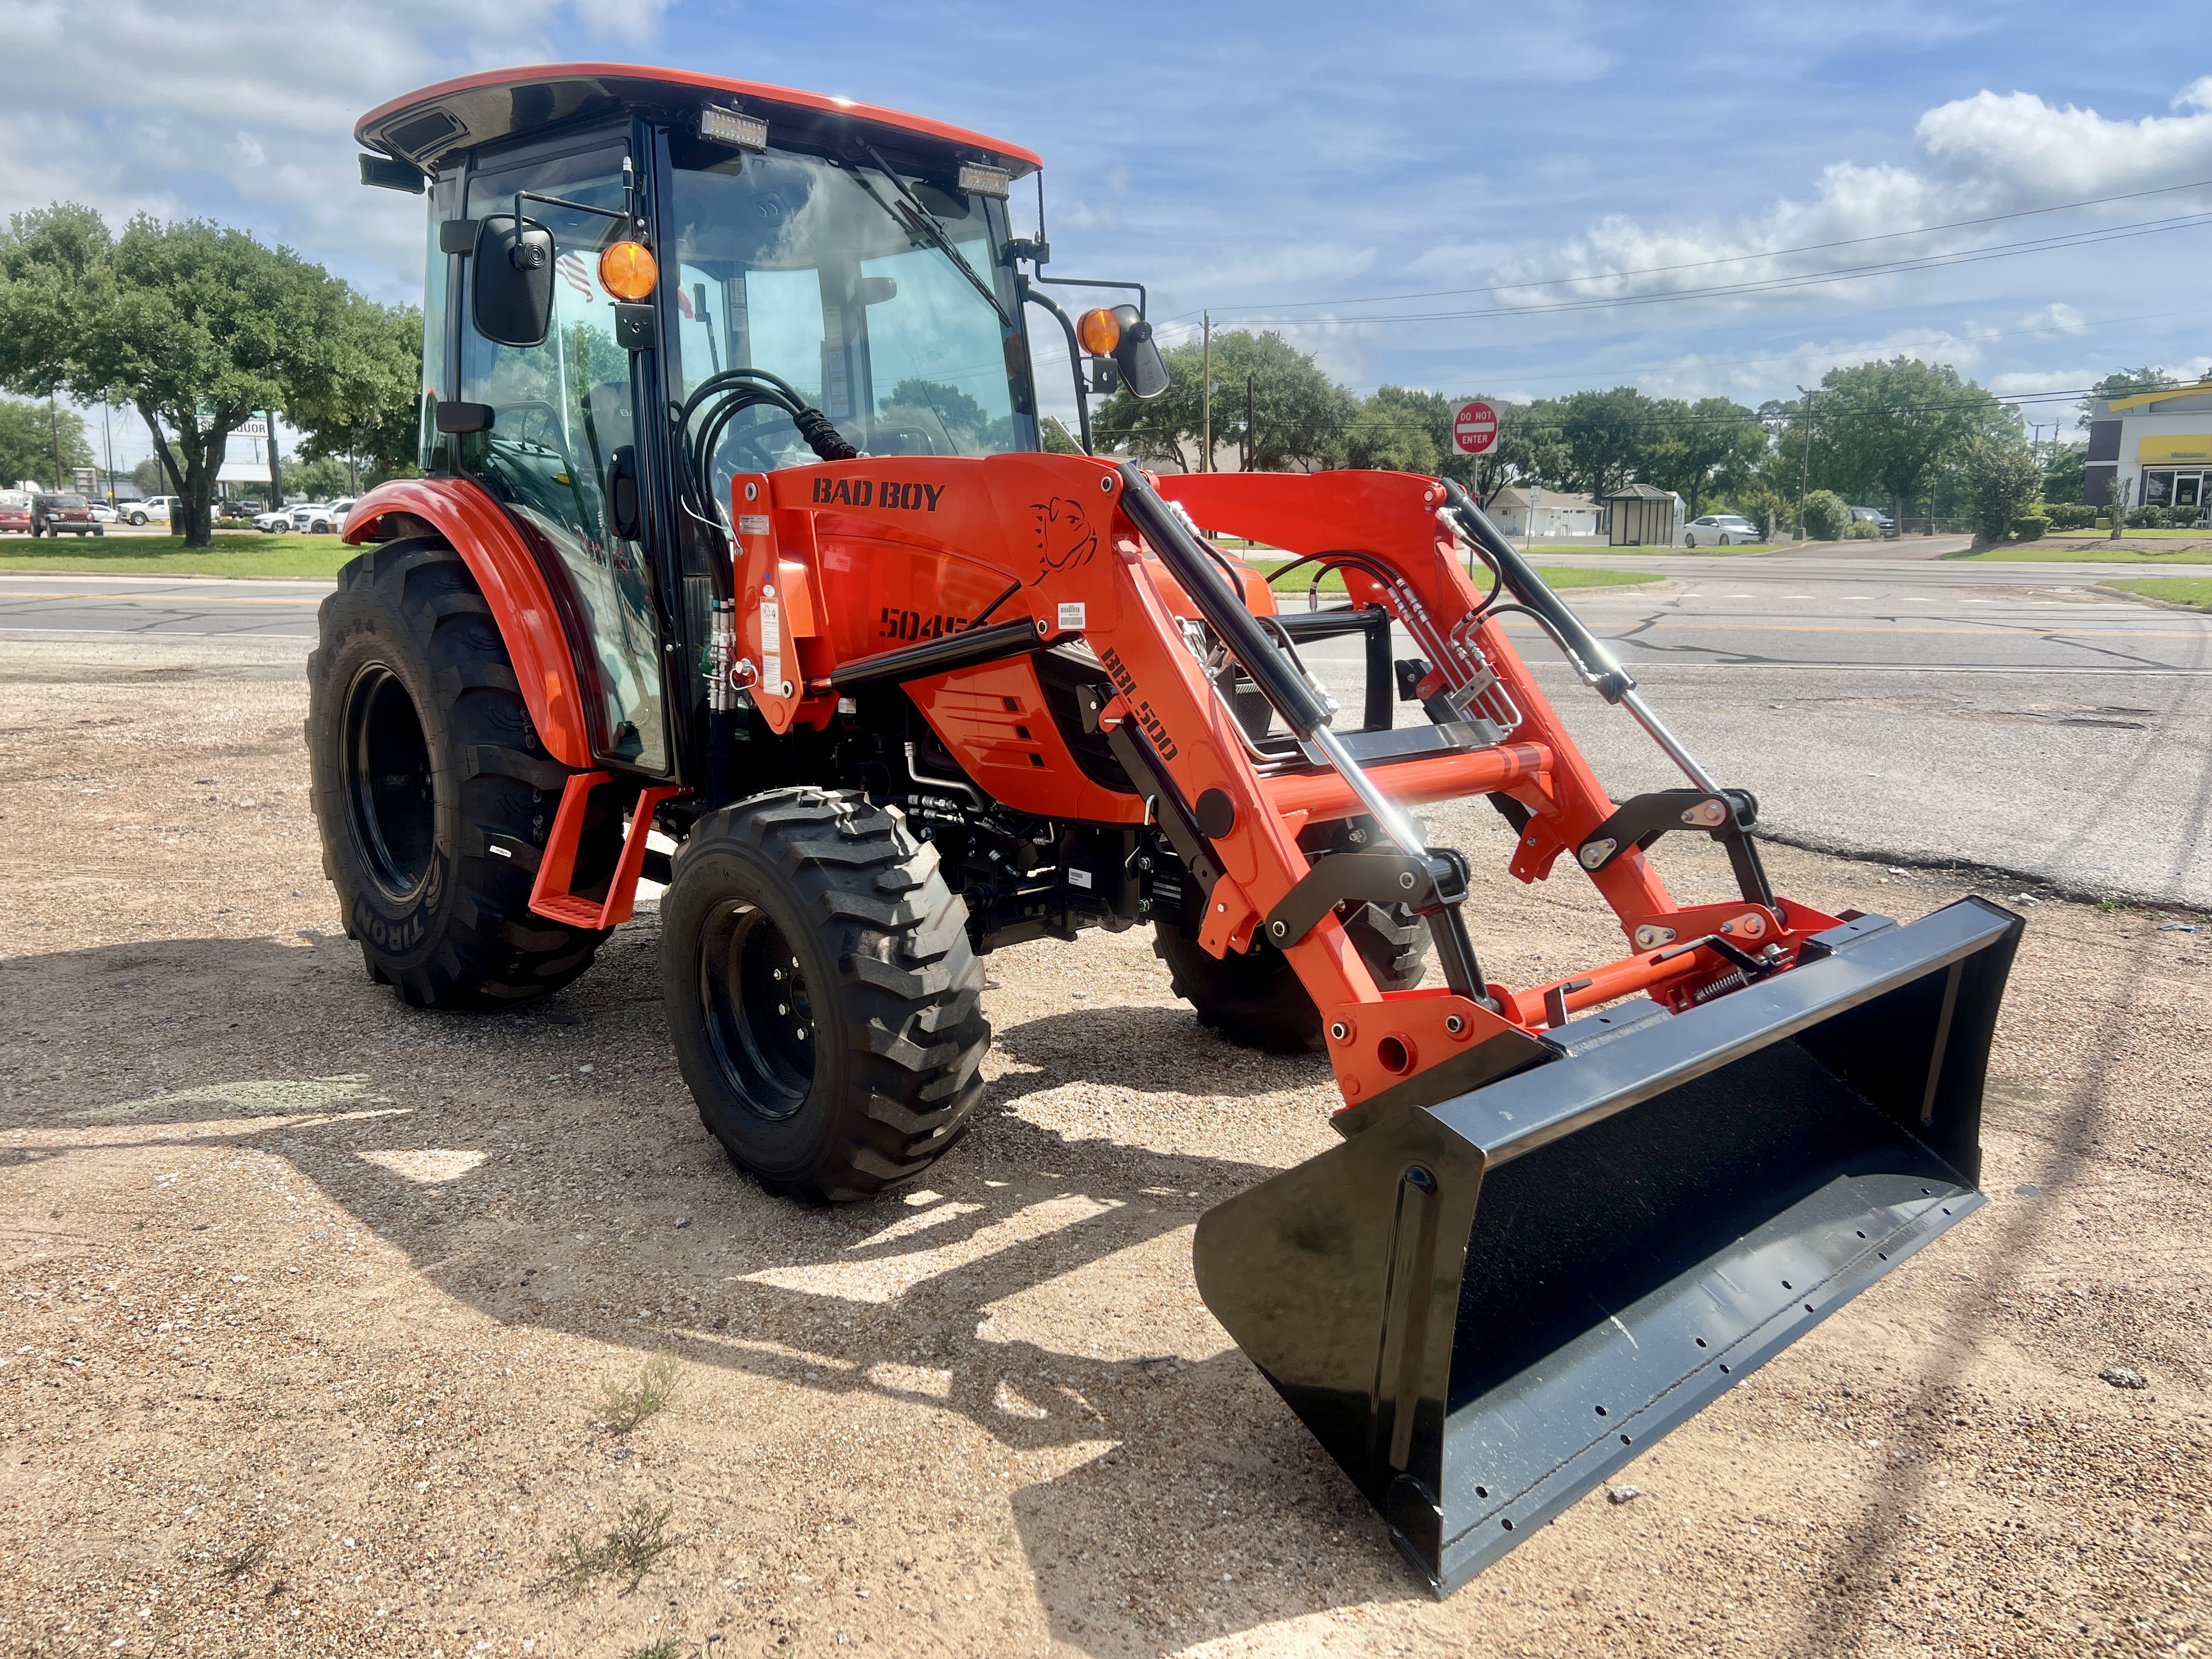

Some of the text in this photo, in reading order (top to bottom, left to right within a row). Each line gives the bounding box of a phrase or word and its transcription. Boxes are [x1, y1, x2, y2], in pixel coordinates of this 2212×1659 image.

[1460, 411, 1492, 421] DO NOT
[1462, 435, 1488, 444] ENTER
[812, 477, 946, 512] BAD BOY
[1101, 646, 1178, 761] BBL 500
[354, 899, 426, 952] TIRON
